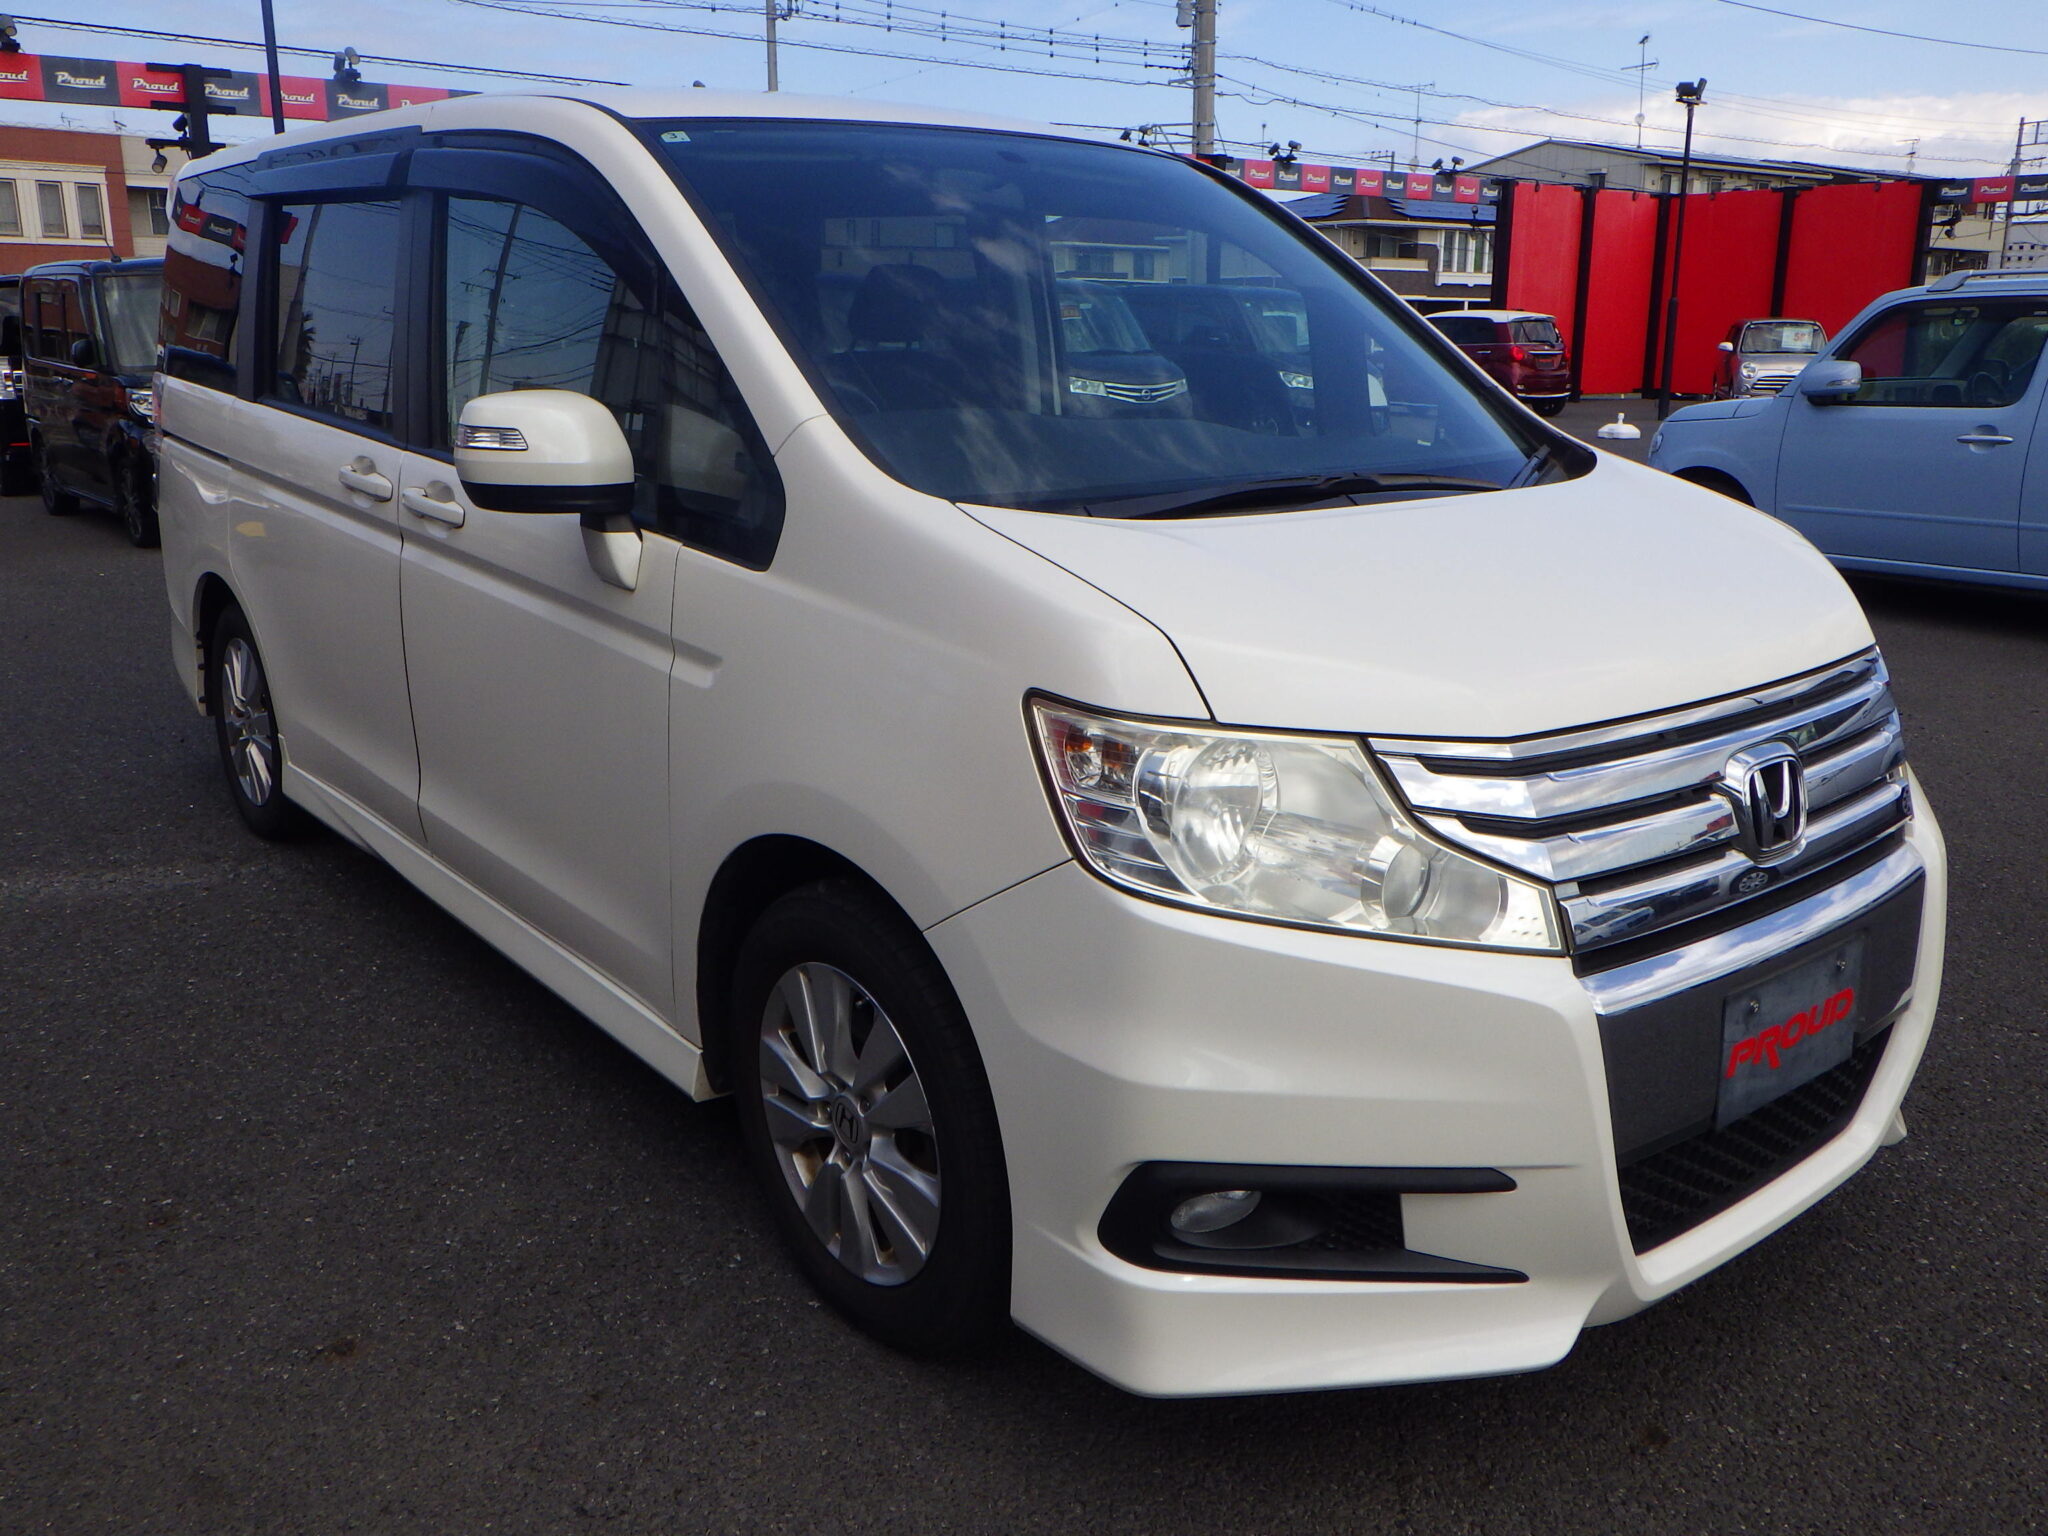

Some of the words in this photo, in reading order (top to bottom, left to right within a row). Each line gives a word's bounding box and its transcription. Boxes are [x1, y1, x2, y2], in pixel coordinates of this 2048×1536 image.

[0, 71, 28, 82] oud
[55, 72, 107, 88] Proud
[132, 78, 180, 93] Proud
[204, 83, 249, 99] Proud
[281, 91, 315, 104] roud
[337, 94, 380, 109] Proud
[1725, 987, 1855, 1079] PROUD
